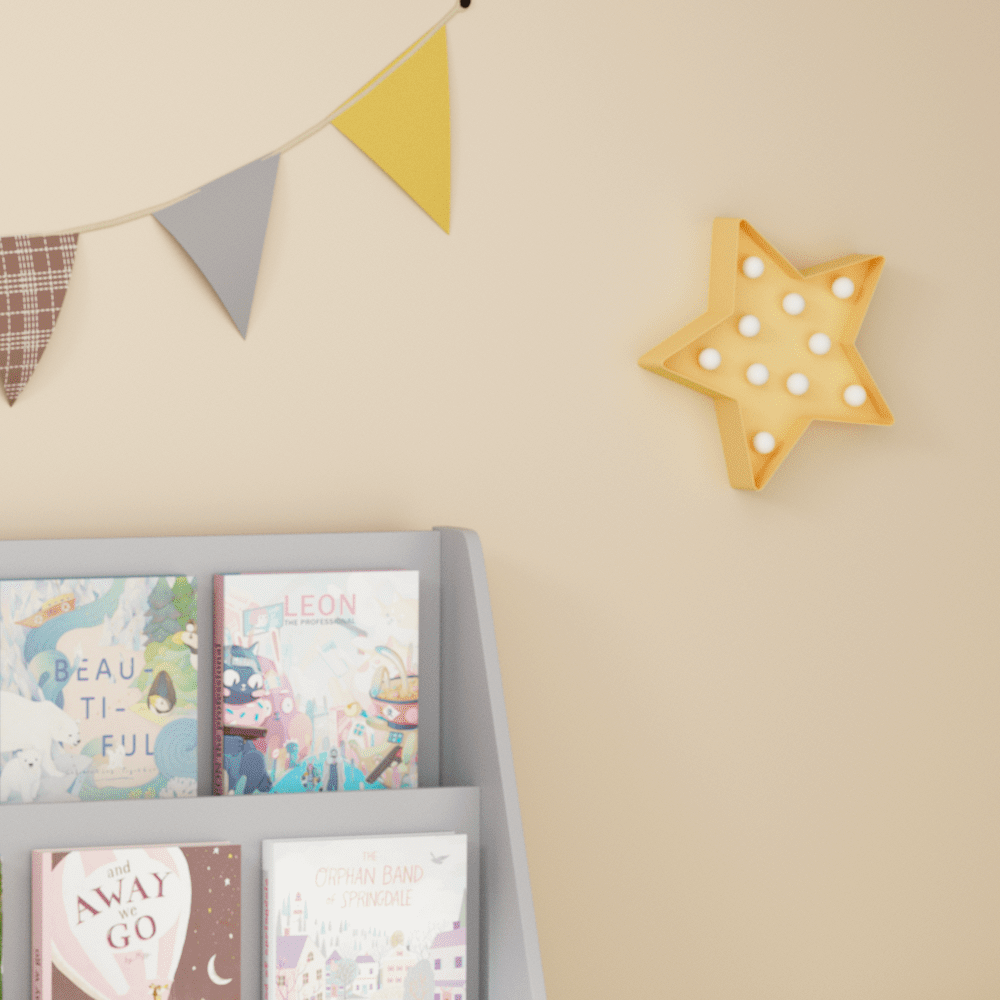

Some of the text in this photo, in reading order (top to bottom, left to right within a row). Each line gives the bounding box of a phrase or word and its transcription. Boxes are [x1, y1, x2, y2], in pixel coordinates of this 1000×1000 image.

[283, 594, 357, 617] LEON
[101, 733, 155, 757] FUL
[107, 860, 131, 879] and
[315, 864, 424, 888] ORPHAN BAND
[76, 871, 172, 926] AWAY
[341, 889, 413, 909] SPRINGDALE
[118, 906, 138, 920] we
[106, 915, 157, 949] GO
